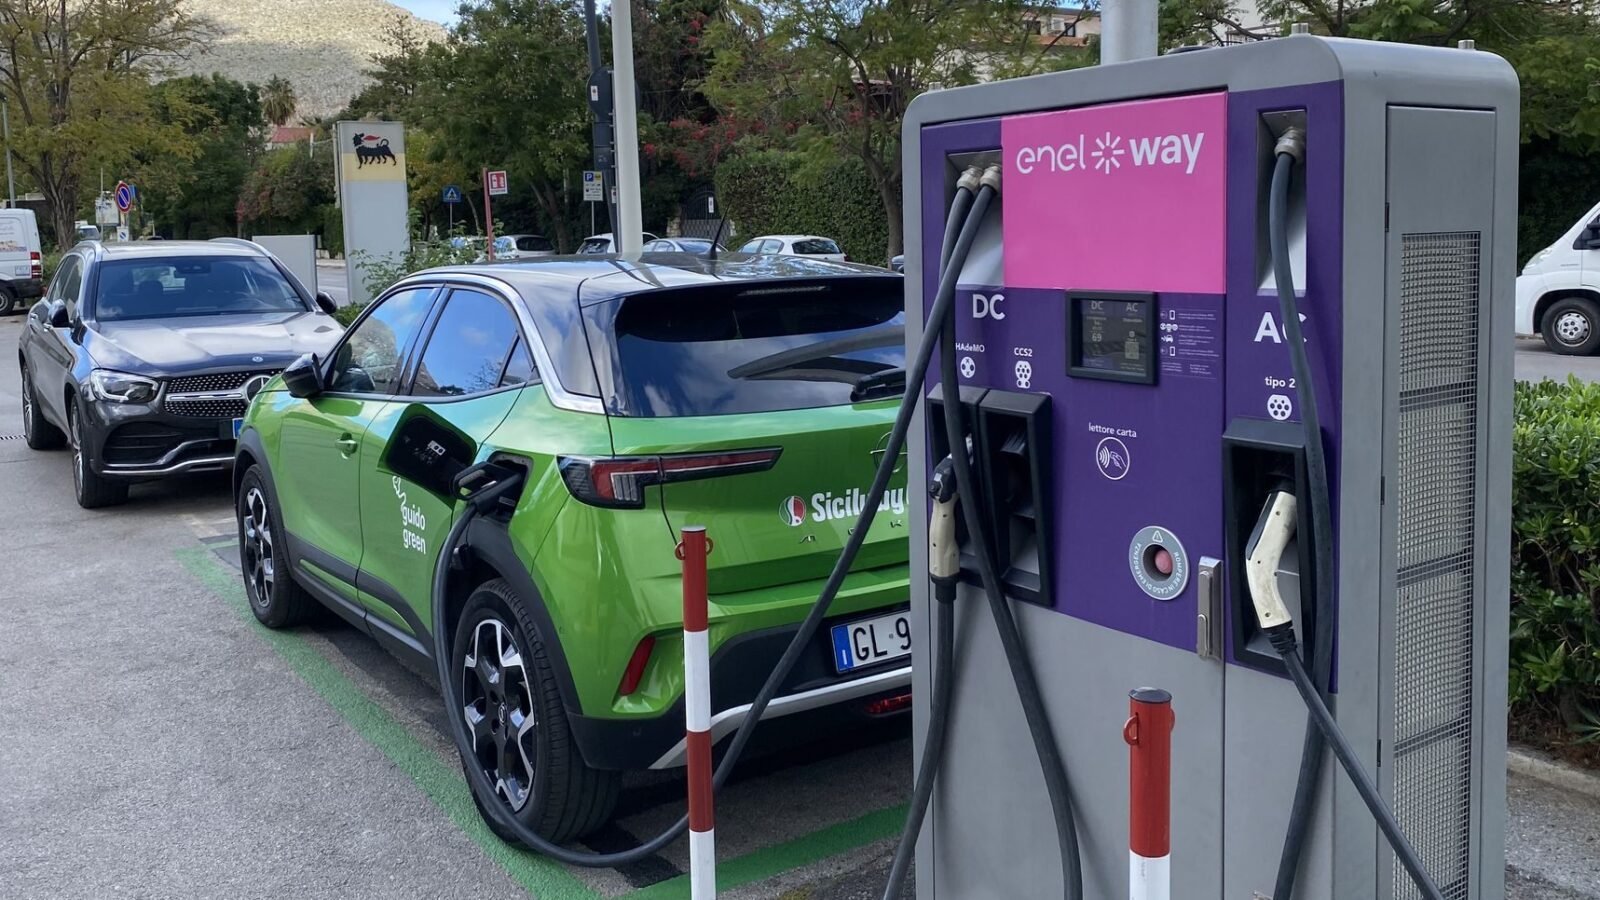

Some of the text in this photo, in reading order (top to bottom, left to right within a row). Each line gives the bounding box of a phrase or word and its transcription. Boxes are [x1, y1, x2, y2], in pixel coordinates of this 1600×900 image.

[1016, 132, 1204, 174] enel way
[972, 293, 1006, 320] DC
[1091, 301, 1104, 310] DC
[1126, 303, 1139, 312] AC
[956, 342, 985, 353] HAdeMO
[1013, 347, 1033, 357] CCS2
[1264, 376, 1296, 389] tipo 2
[1088, 421, 1137, 438] lettore carta
[811, 487, 909, 523] Sicily
[401, 504, 426, 531] guido
[402, 528, 426, 555] green
[853, 624, 888, 661] GL
